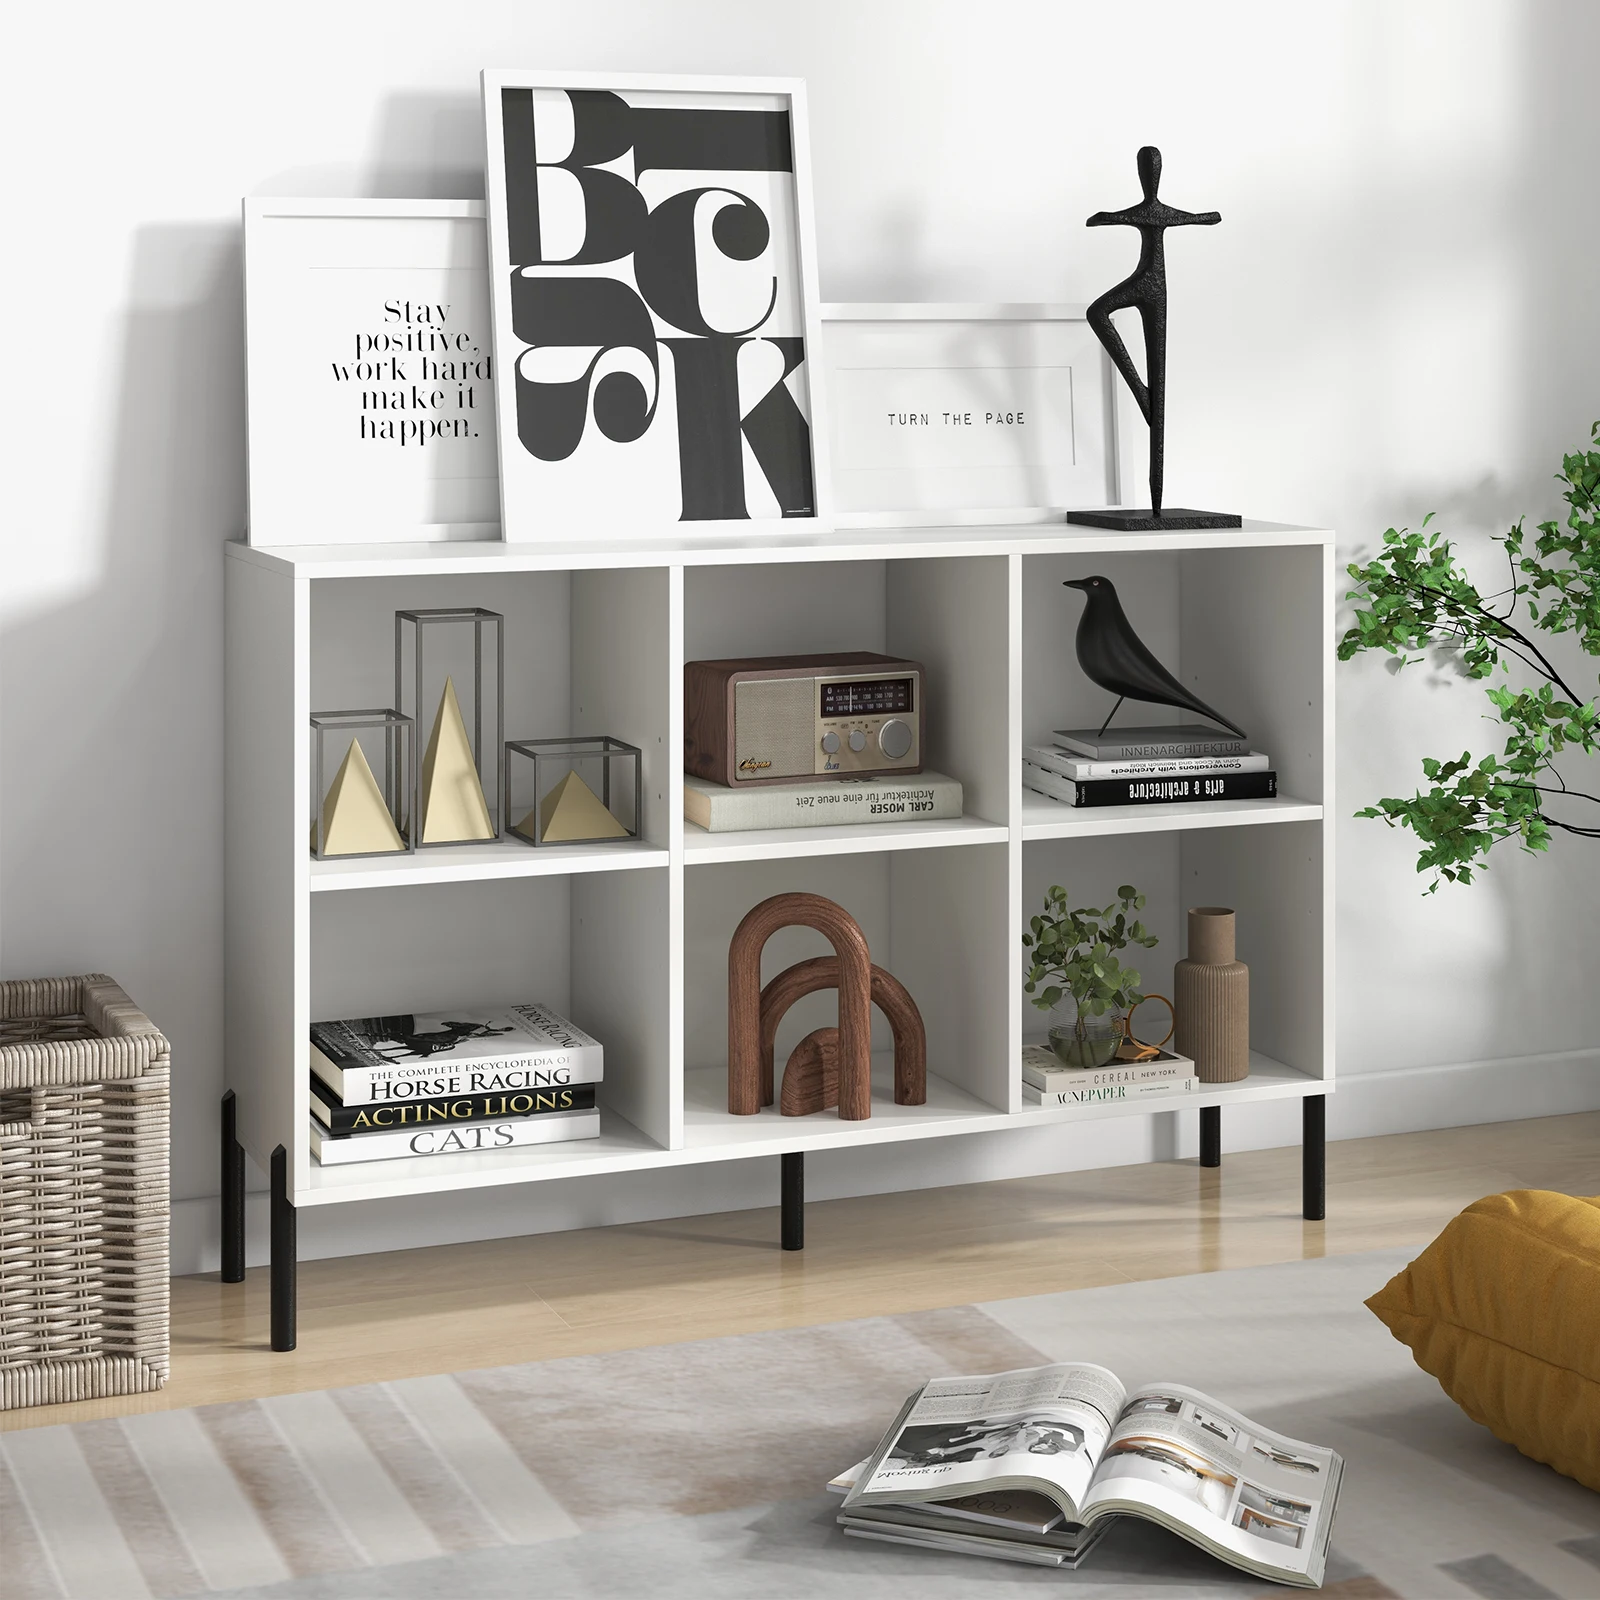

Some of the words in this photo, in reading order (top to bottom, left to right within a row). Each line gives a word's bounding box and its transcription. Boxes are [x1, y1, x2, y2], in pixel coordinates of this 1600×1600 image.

[384, 299, 451, 331] Stay
[356, 326, 480, 360] positive,
[332, 357, 407, 381] work
[422, 356, 492, 380] hard
[362, 385, 445, 410] make
[456, 383, 478, 409] it
[888, 413, 929, 425] TURN
[942, 412, 972, 425] THE
[985, 412, 1025, 425] PAGE
[361, 415, 479, 446] happen.
[1121, 742, 1242, 757] INNENARCHITEKTUR
[1110, 767, 1156, 775] Architects
[1158, 765, 1177, 773] with
[1178, 763, 1242, 772] Conversations
[1128, 781, 1189, 799] architecture
[1205, 779, 1224, 796] arts
[796, 796, 815, 808] Zeit
[817, 795, 840, 805] neue
[843, 793, 863, 804] eine
[865, 792, 879, 803] für
[882, 790, 934, 803] Architektur
[870, 803, 905, 814] MOSER
[908, 801, 934, 811] CARL
[369, 1071, 394, 1081] THE
[398, 1065, 461, 1078] COMPLETE
[465, 1057, 554, 1073] ENCYCLOPEDIA
[556, 1055, 572, 1065] OF
[369, 1076, 461, 1101] HORSE
[470, 1067, 572, 1092] RACING
[1093, 1071, 1136, 1085] CEREAL
[350, 1099, 474, 1129] ACTING
[483, 1090, 574, 1117] LIONS
[409, 1124, 515, 1155] CATS
